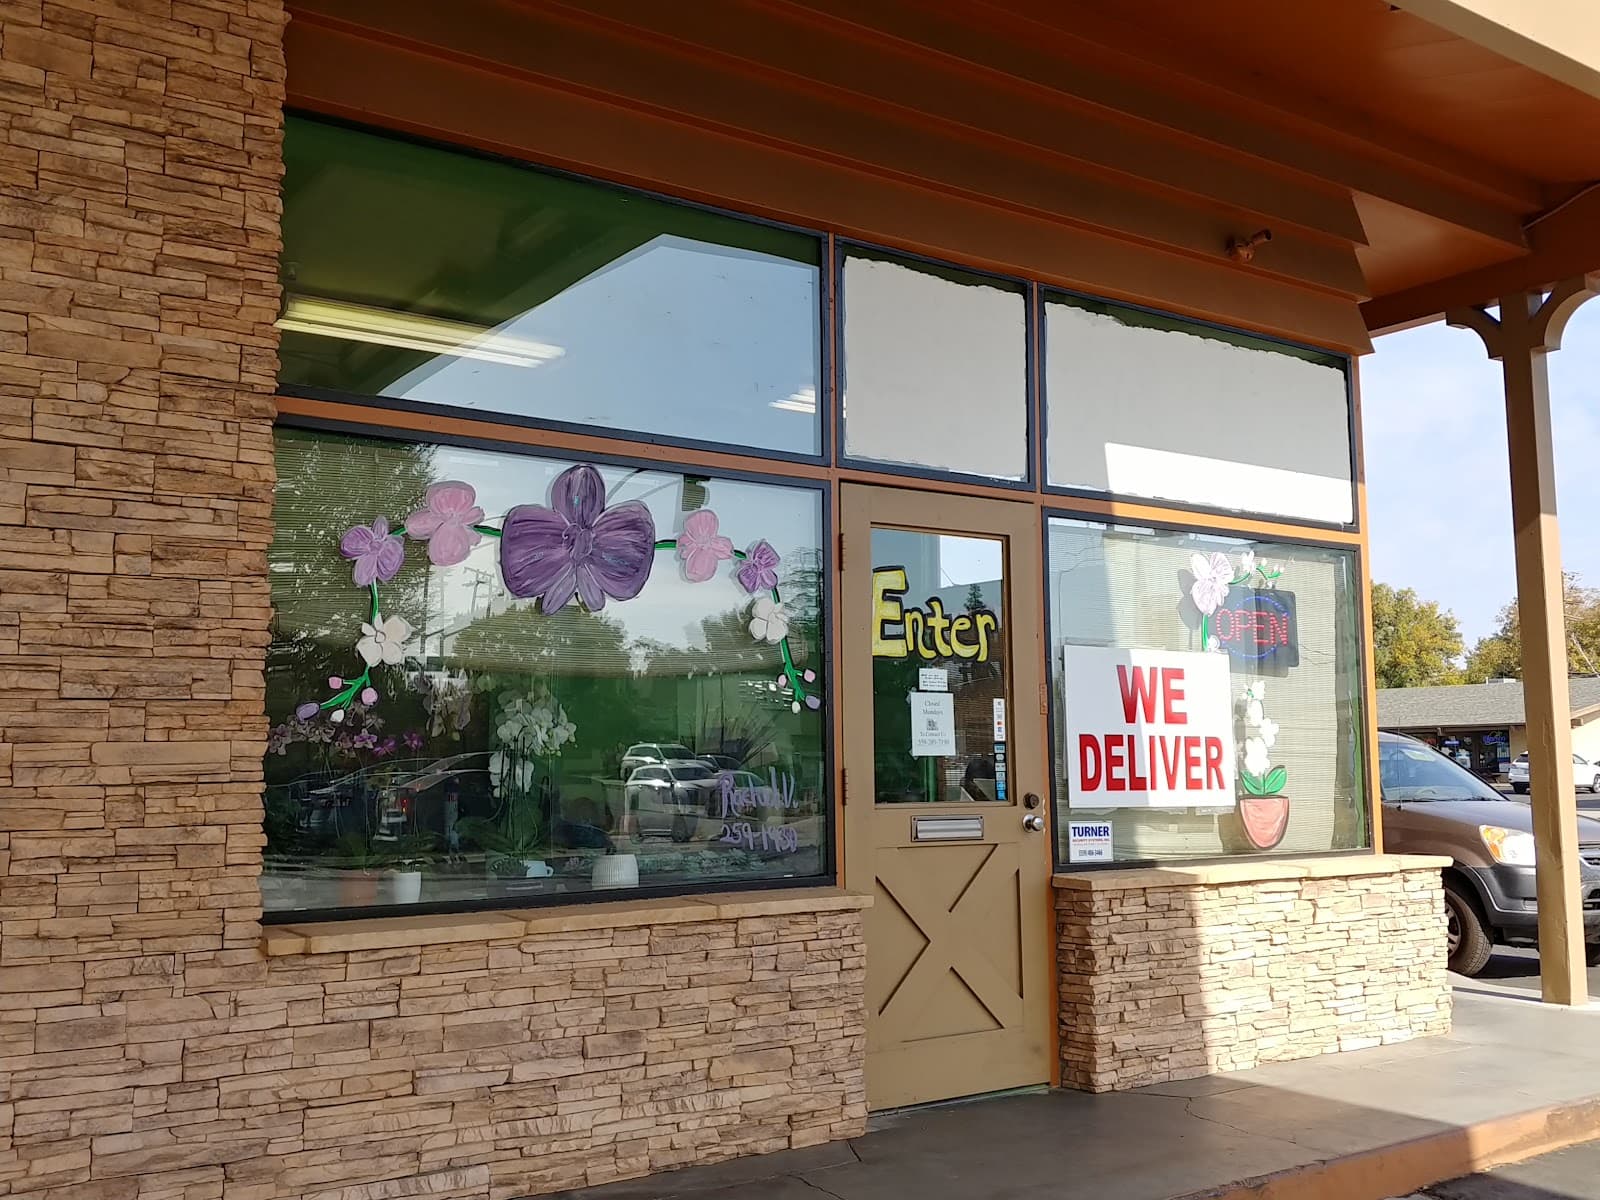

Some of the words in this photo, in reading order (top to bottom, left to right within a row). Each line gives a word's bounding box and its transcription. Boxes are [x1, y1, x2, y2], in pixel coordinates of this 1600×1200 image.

[871, 565, 997, 664] Enter
[1216, 608, 1288, 646] OPEN
[1116, 664, 1188, 724] WE
[1079, 734, 1226, 791] DELIVER
[1072, 826, 1110, 837] TURNER
